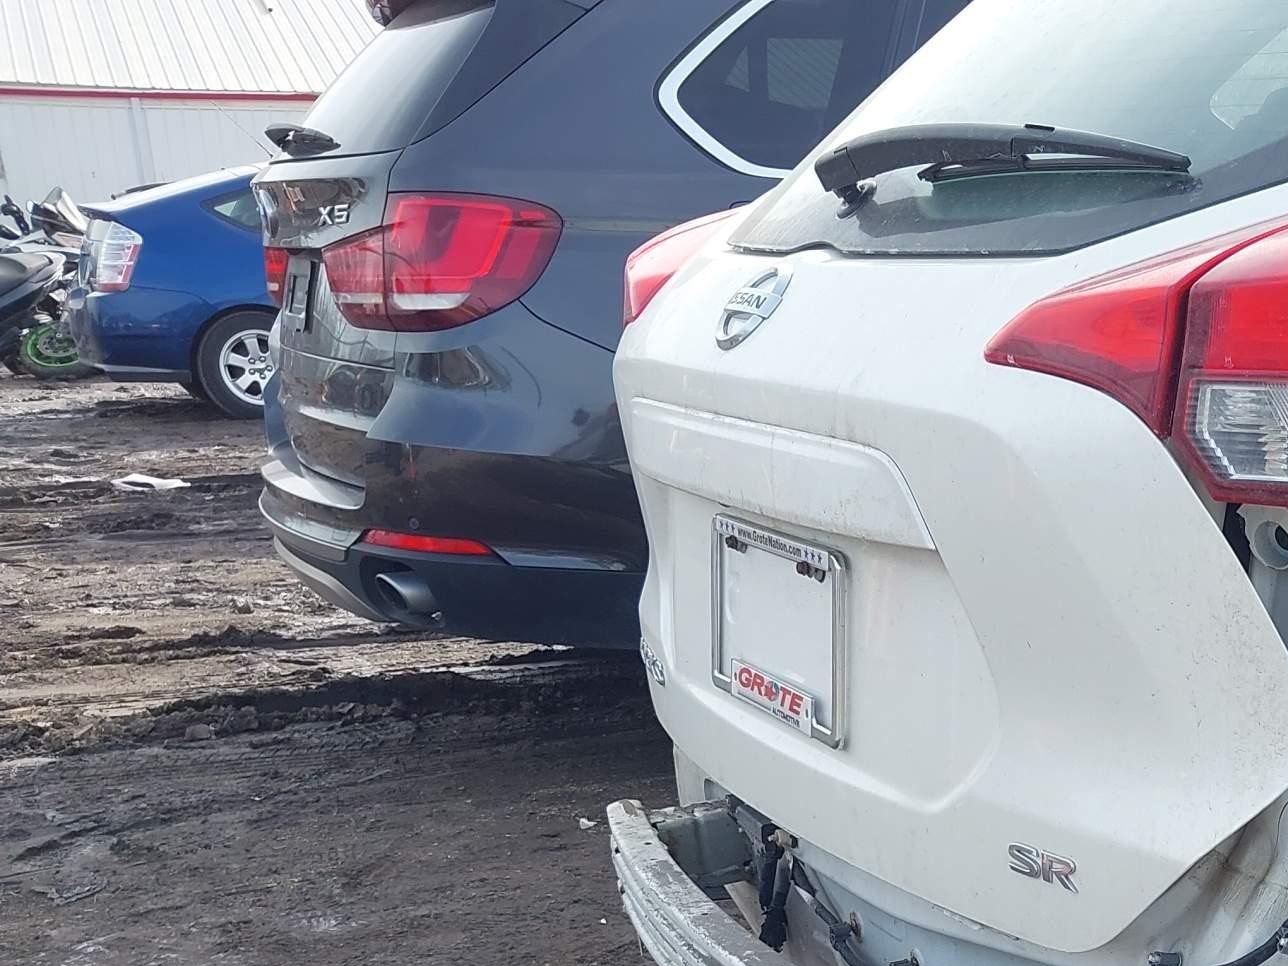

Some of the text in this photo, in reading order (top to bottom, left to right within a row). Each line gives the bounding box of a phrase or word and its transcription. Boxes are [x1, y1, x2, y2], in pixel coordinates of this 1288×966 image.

[318, 204, 351, 226] X5
[727, 292, 767, 310] ISSAN
[737, 526, 802, 558] www.GroteNation.com
[738, 667, 804, 716] GROTE
[1008, 842, 1079, 894] SR
